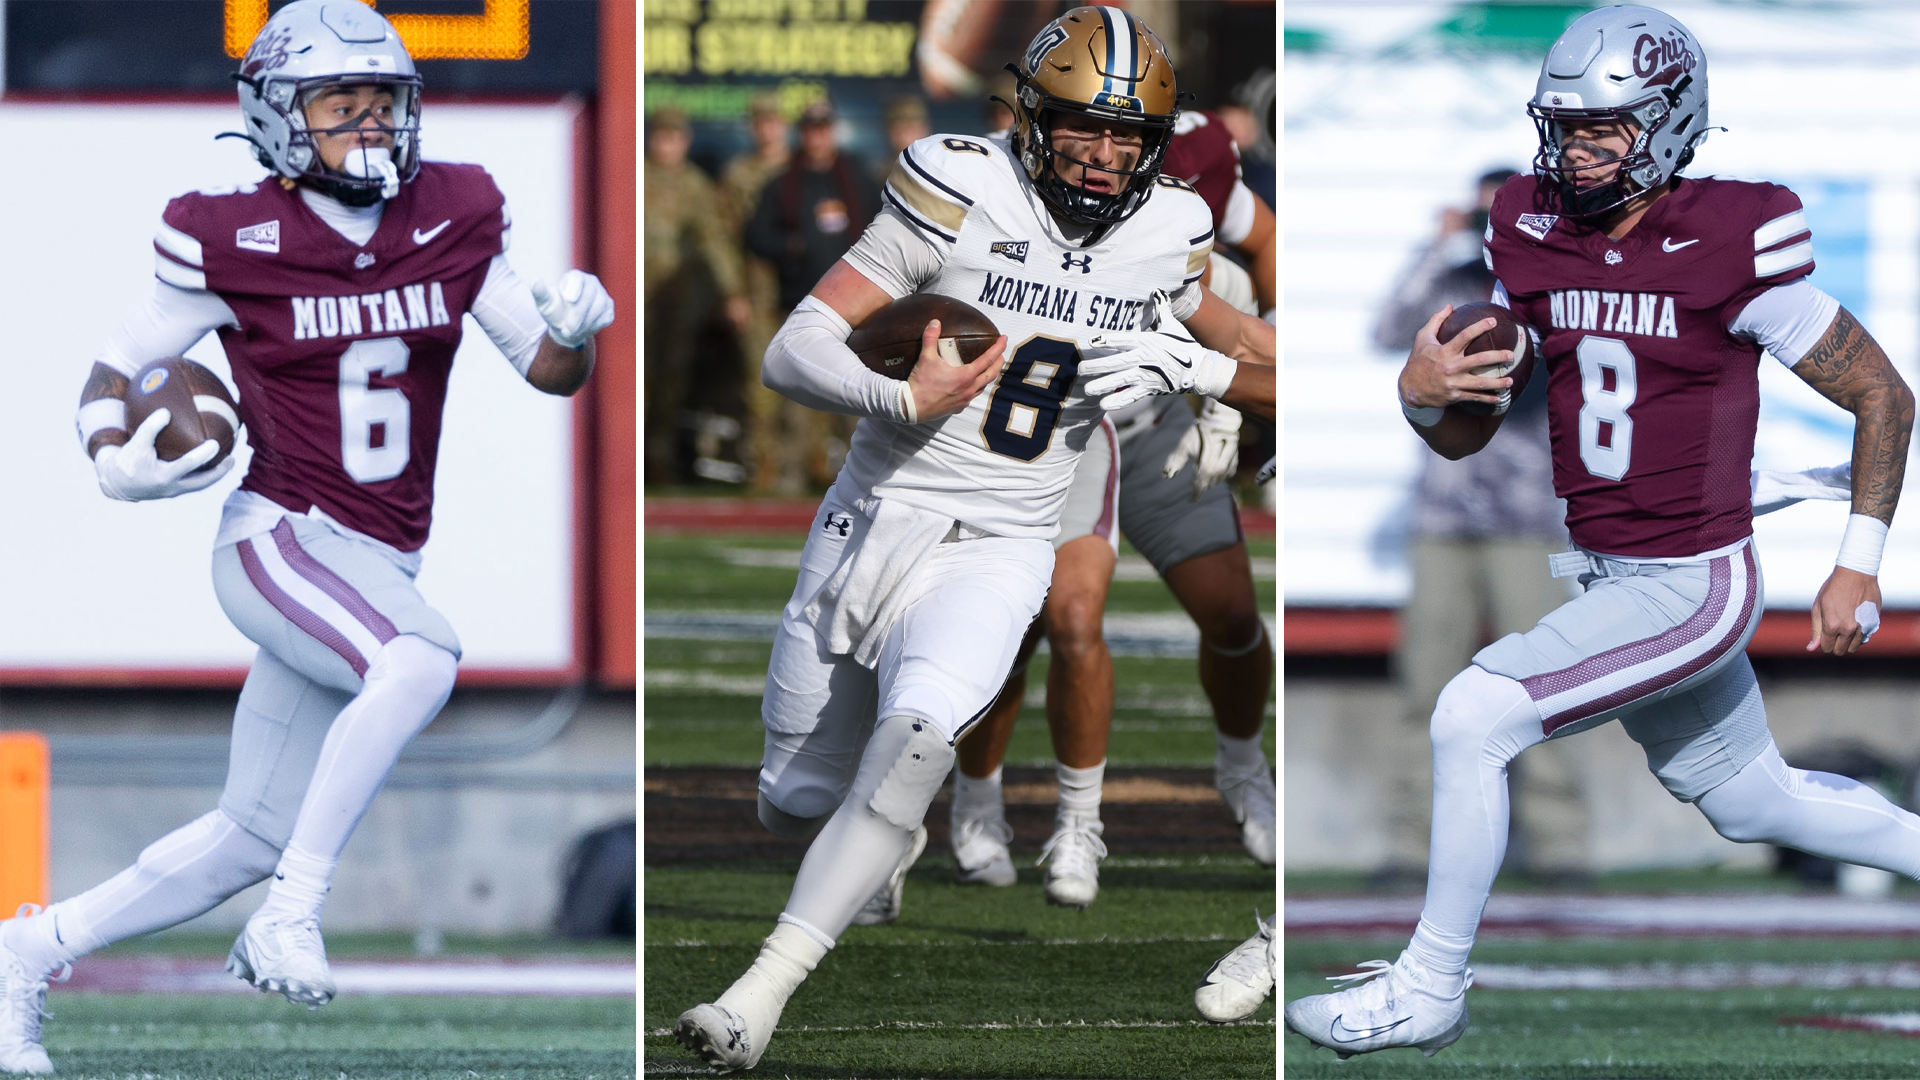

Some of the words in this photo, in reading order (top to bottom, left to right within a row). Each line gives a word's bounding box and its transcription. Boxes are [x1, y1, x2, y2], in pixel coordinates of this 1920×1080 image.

[1633, 31, 1697, 78] Griz
[1106, 94, 1131, 109] 406
[291, 281, 450, 340] MONTANA
[978, 272, 1078, 323] MONTANA
[1086, 294, 1144, 331] STATE
[1548, 288, 1678, 339] MONTANA
[338, 336, 411, 484] 6
[979, 332, 1085, 464] 8
[1576, 334, 1637, 482] 8
